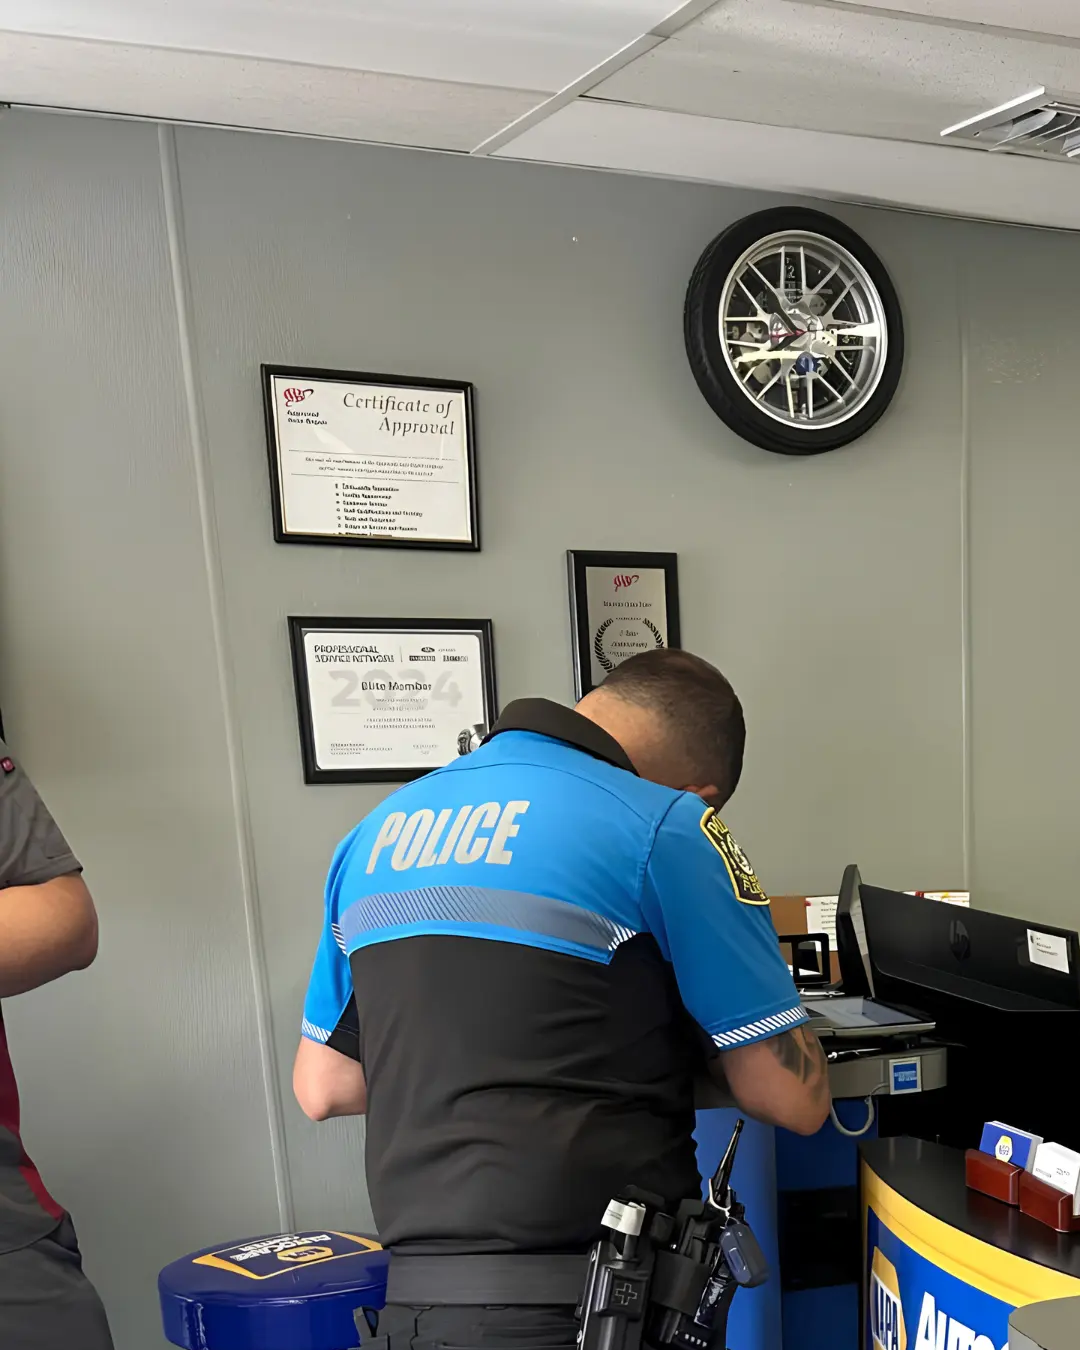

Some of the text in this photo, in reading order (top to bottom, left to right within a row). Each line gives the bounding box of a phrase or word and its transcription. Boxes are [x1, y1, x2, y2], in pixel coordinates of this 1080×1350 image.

[343, 392, 454, 419] Certificate of
[378, 416, 455, 437] Approval
[327, 668, 464, 712] 2024
[365, 800, 531, 875] POLICE
